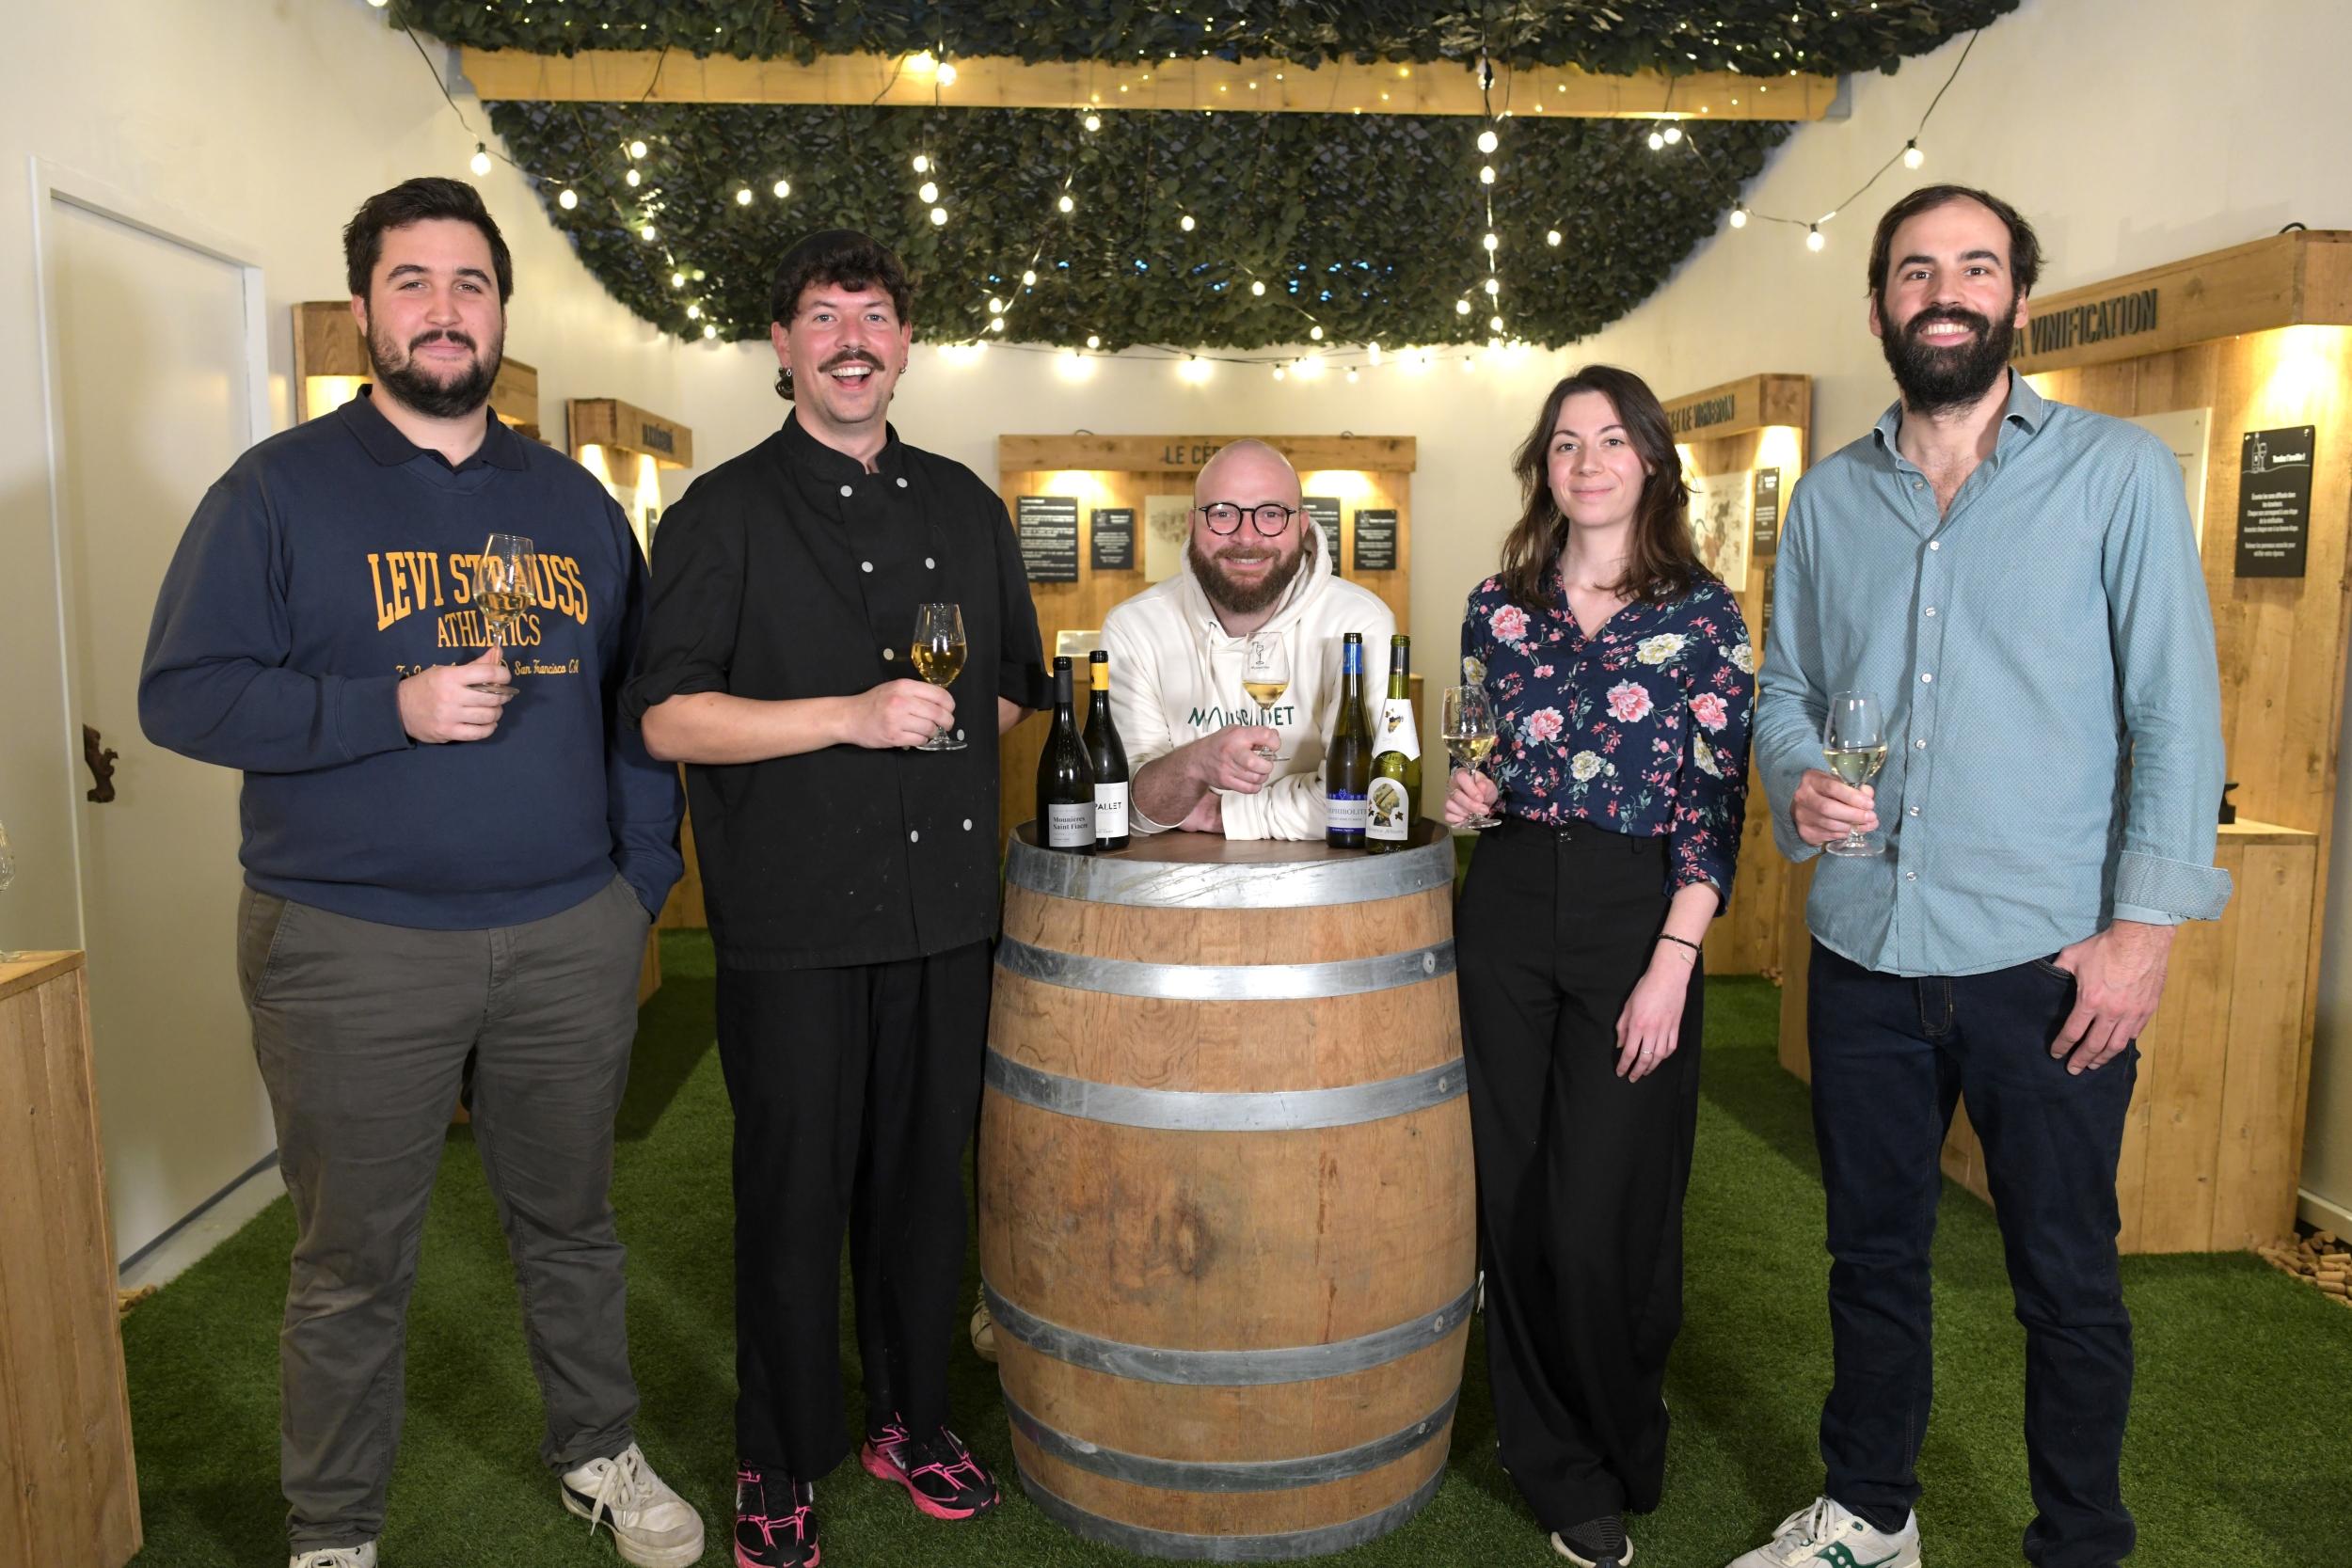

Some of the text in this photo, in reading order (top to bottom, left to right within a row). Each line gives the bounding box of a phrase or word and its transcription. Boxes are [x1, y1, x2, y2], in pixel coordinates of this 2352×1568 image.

[2030, 288, 2157, 356] VINIFICATION
[1166, 445, 1185, 465] LE
[367, 551, 589, 631] LEVI STRAUSS
[514, 660, 532, 676] San
